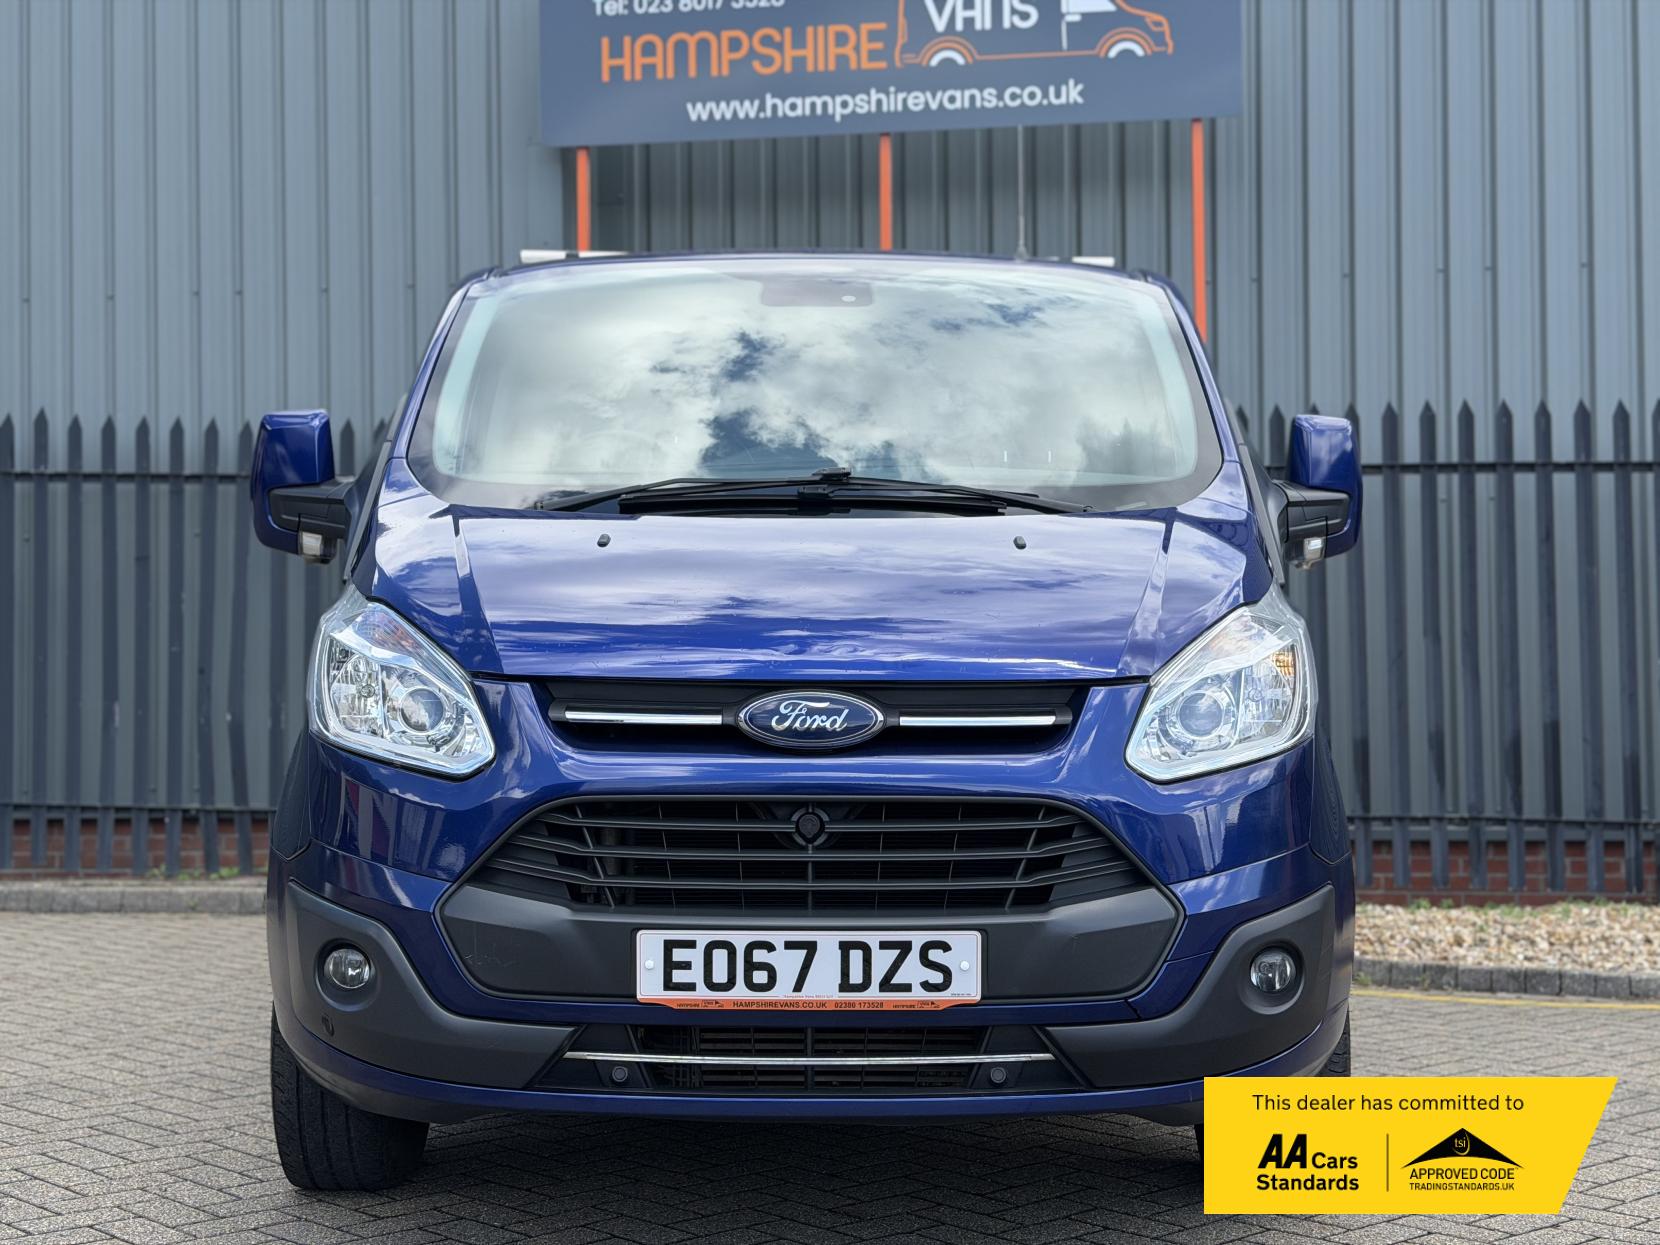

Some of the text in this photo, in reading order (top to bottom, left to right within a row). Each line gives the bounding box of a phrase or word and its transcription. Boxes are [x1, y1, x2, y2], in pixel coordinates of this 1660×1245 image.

[594, 0, 629, 16] Tel:
[601, 22, 887, 83] HAMPSHIRE
[686, 78, 1084, 122] www.hampshirevans.co.uk
[771, 700, 849, 731] Ford
[838, 940, 953, 993] DZS
[732, 1001, 828, 1009] HAMPSHIREVANS.CO.UK
